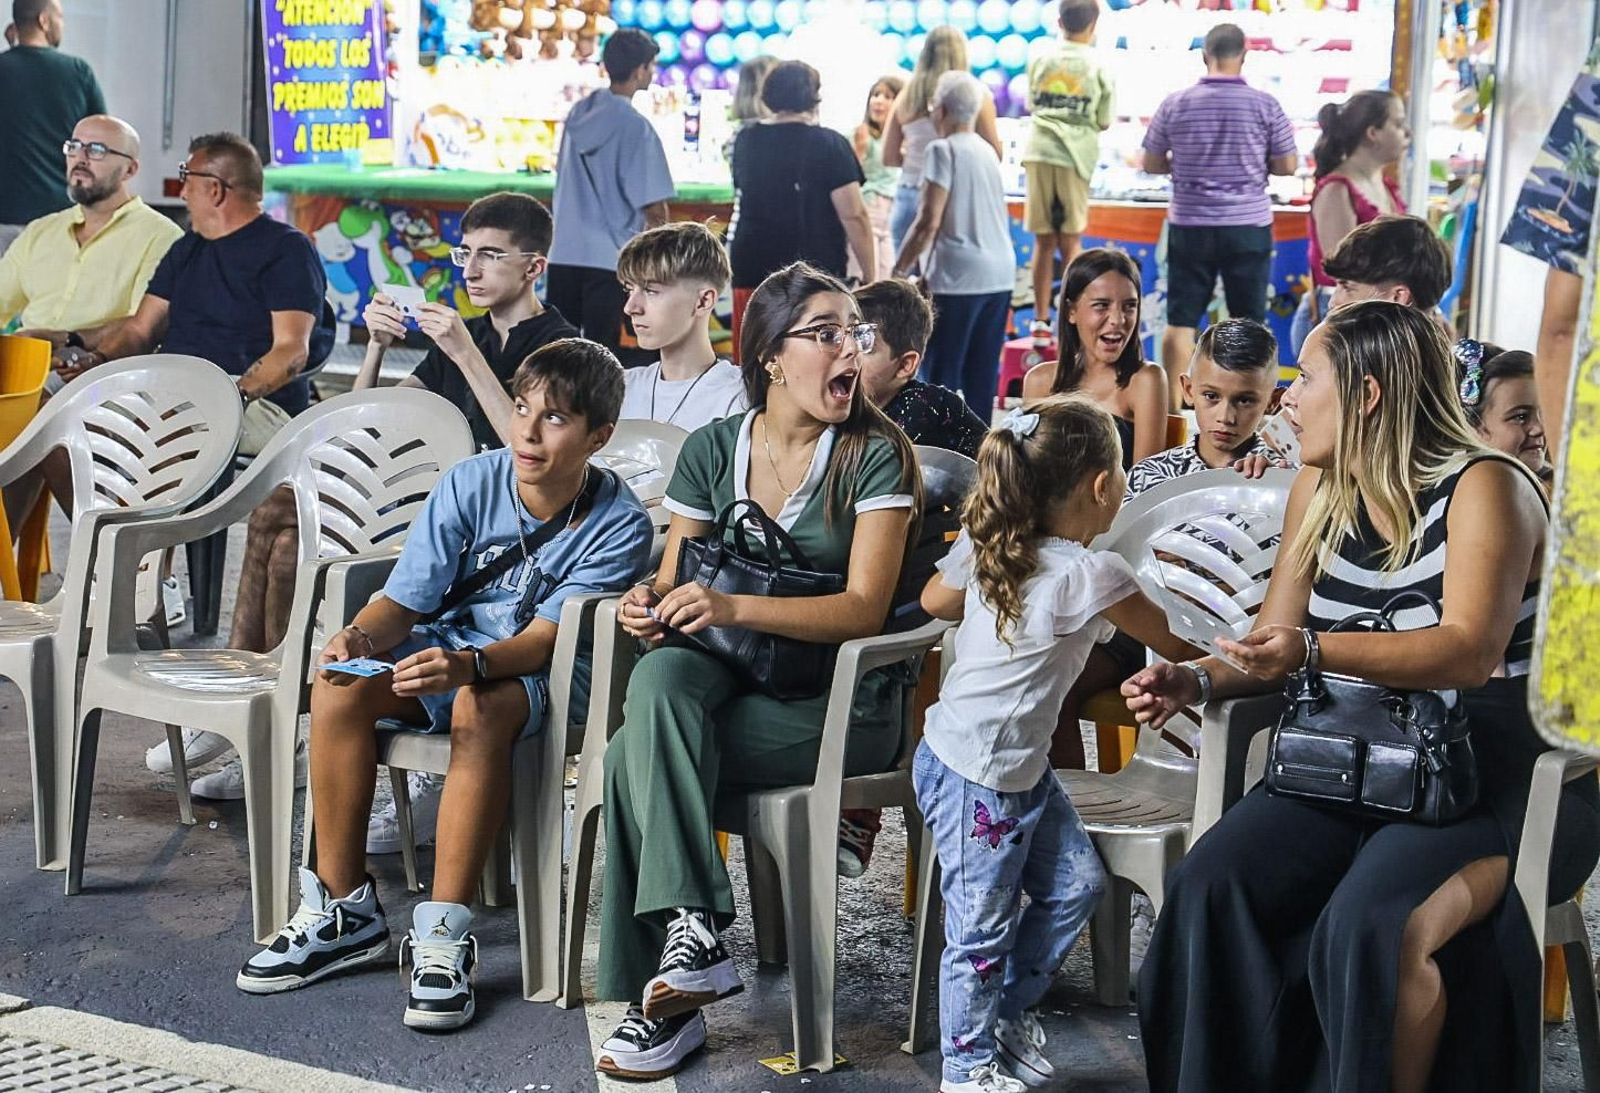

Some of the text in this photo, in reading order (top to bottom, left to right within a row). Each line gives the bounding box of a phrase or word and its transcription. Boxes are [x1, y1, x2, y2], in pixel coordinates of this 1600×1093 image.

[283, 37, 372, 68] TODOS LOS
[273, 80, 386, 112] PREMIOS SON
[294, 124, 307, 153] A
